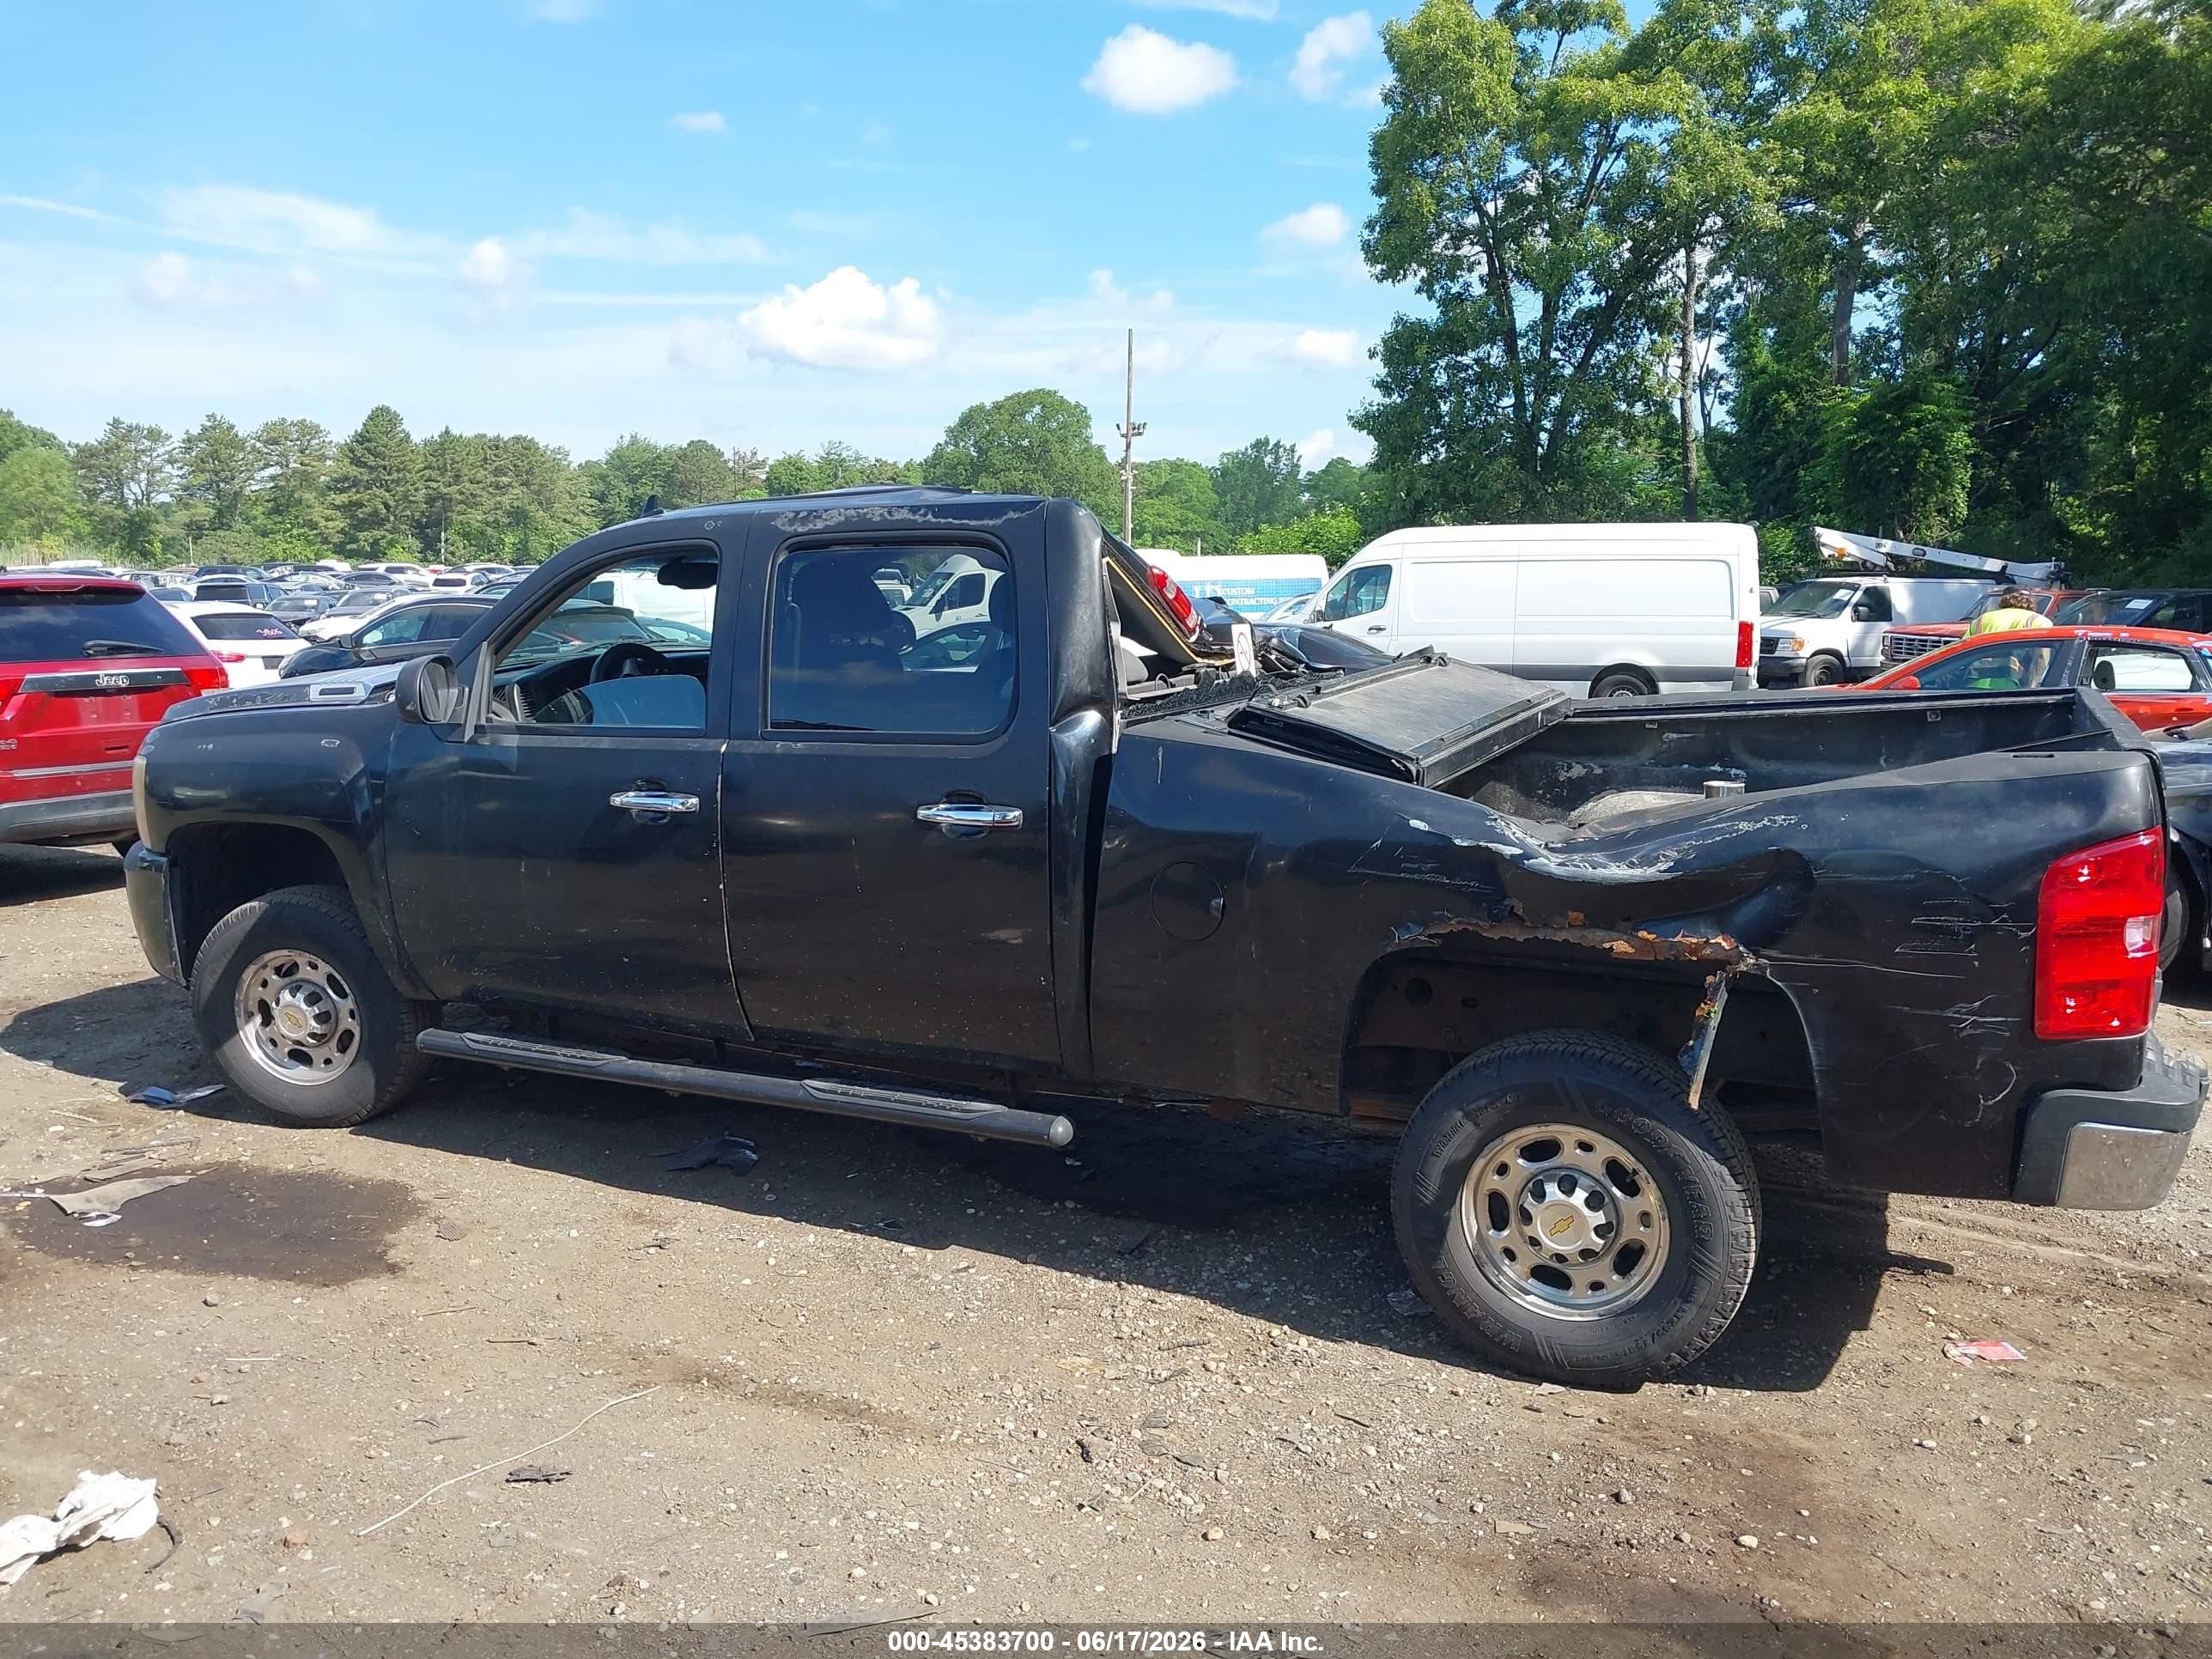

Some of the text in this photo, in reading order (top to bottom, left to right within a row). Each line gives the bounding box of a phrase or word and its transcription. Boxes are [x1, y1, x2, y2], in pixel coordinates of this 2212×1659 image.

[1220, 586, 1255, 596] CUSTOM
[1225, 597, 1278, 605] ONTRACTING
[95, 673, 130, 688] Jeep
